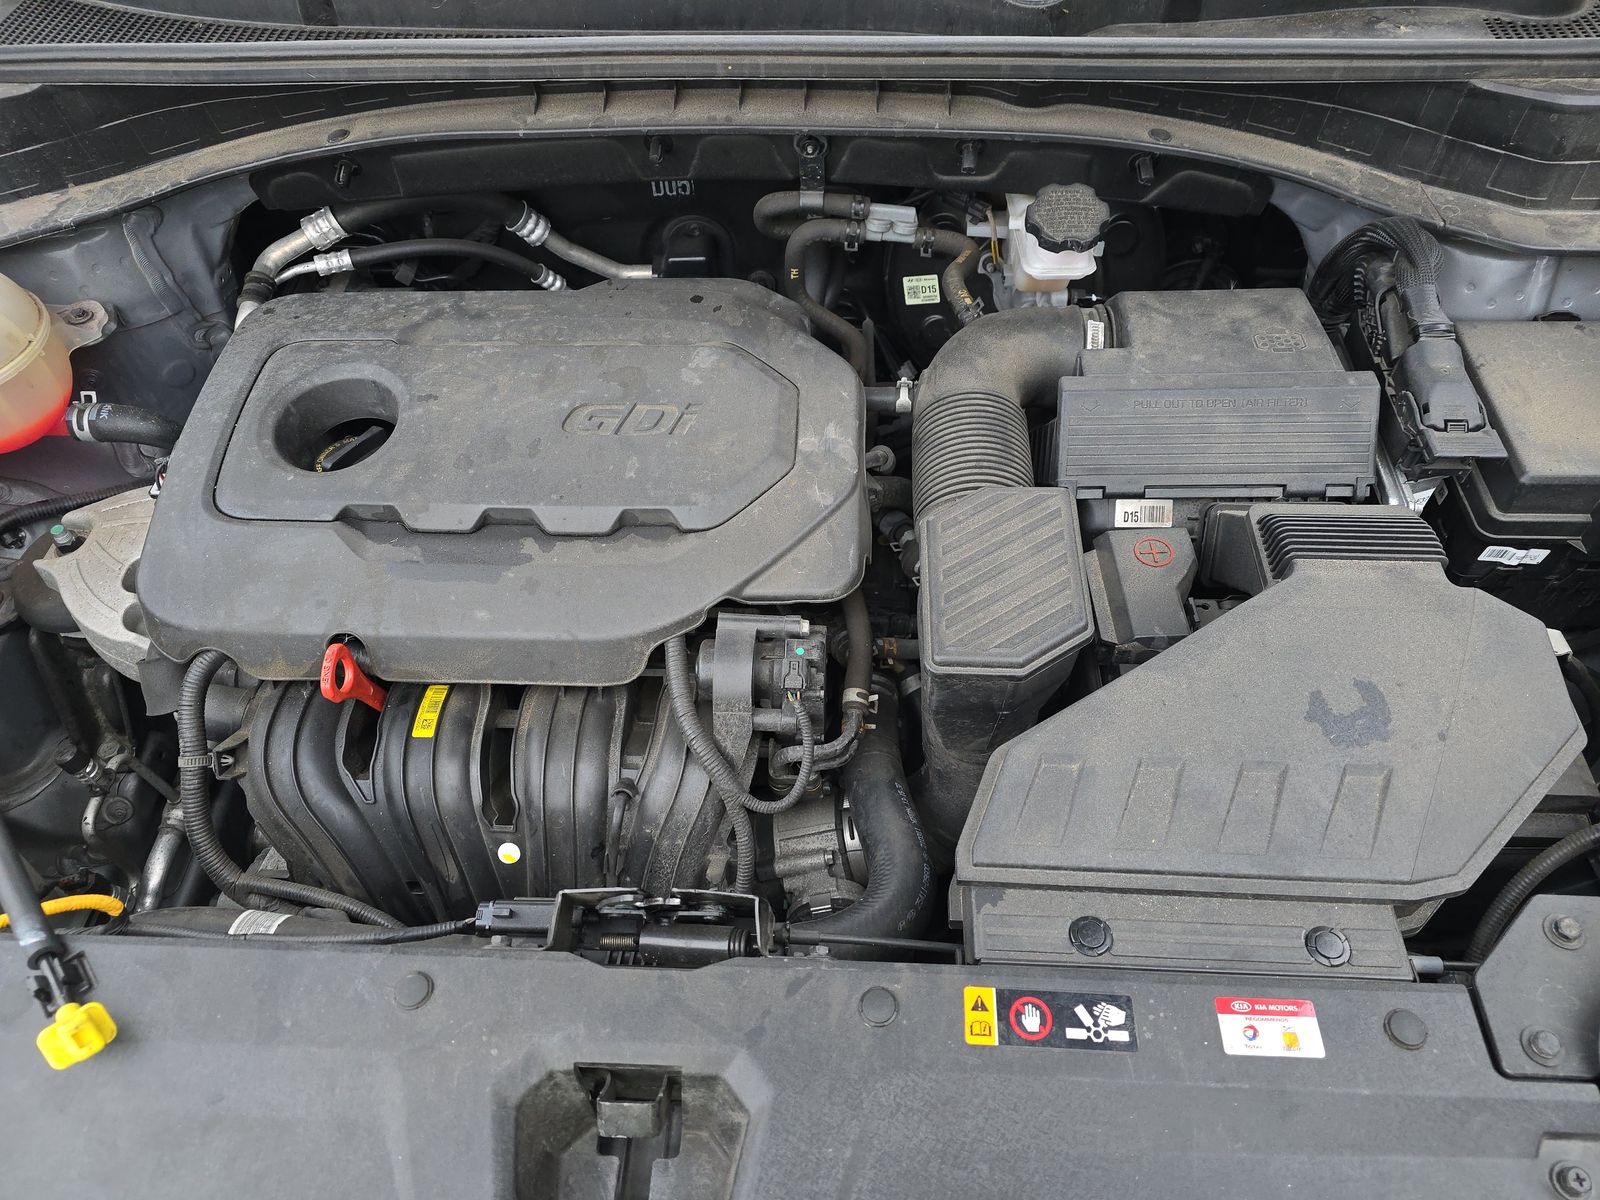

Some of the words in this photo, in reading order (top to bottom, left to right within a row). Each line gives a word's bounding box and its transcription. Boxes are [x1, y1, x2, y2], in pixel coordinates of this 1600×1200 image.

[921, 285, 937, 294] D15
[1133, 400, 1162, 409] PULL
[1163, 399, 1186, 409] OUT
[1190, 399, 1204, 408] TO
[1206, 398, 1237, 408] OPEN
[1123, 511, 1139, 523] D15
[1254, 1003, 1268, 1011] KIA
[1268, 1004, 1299, 1012] MOTORS
